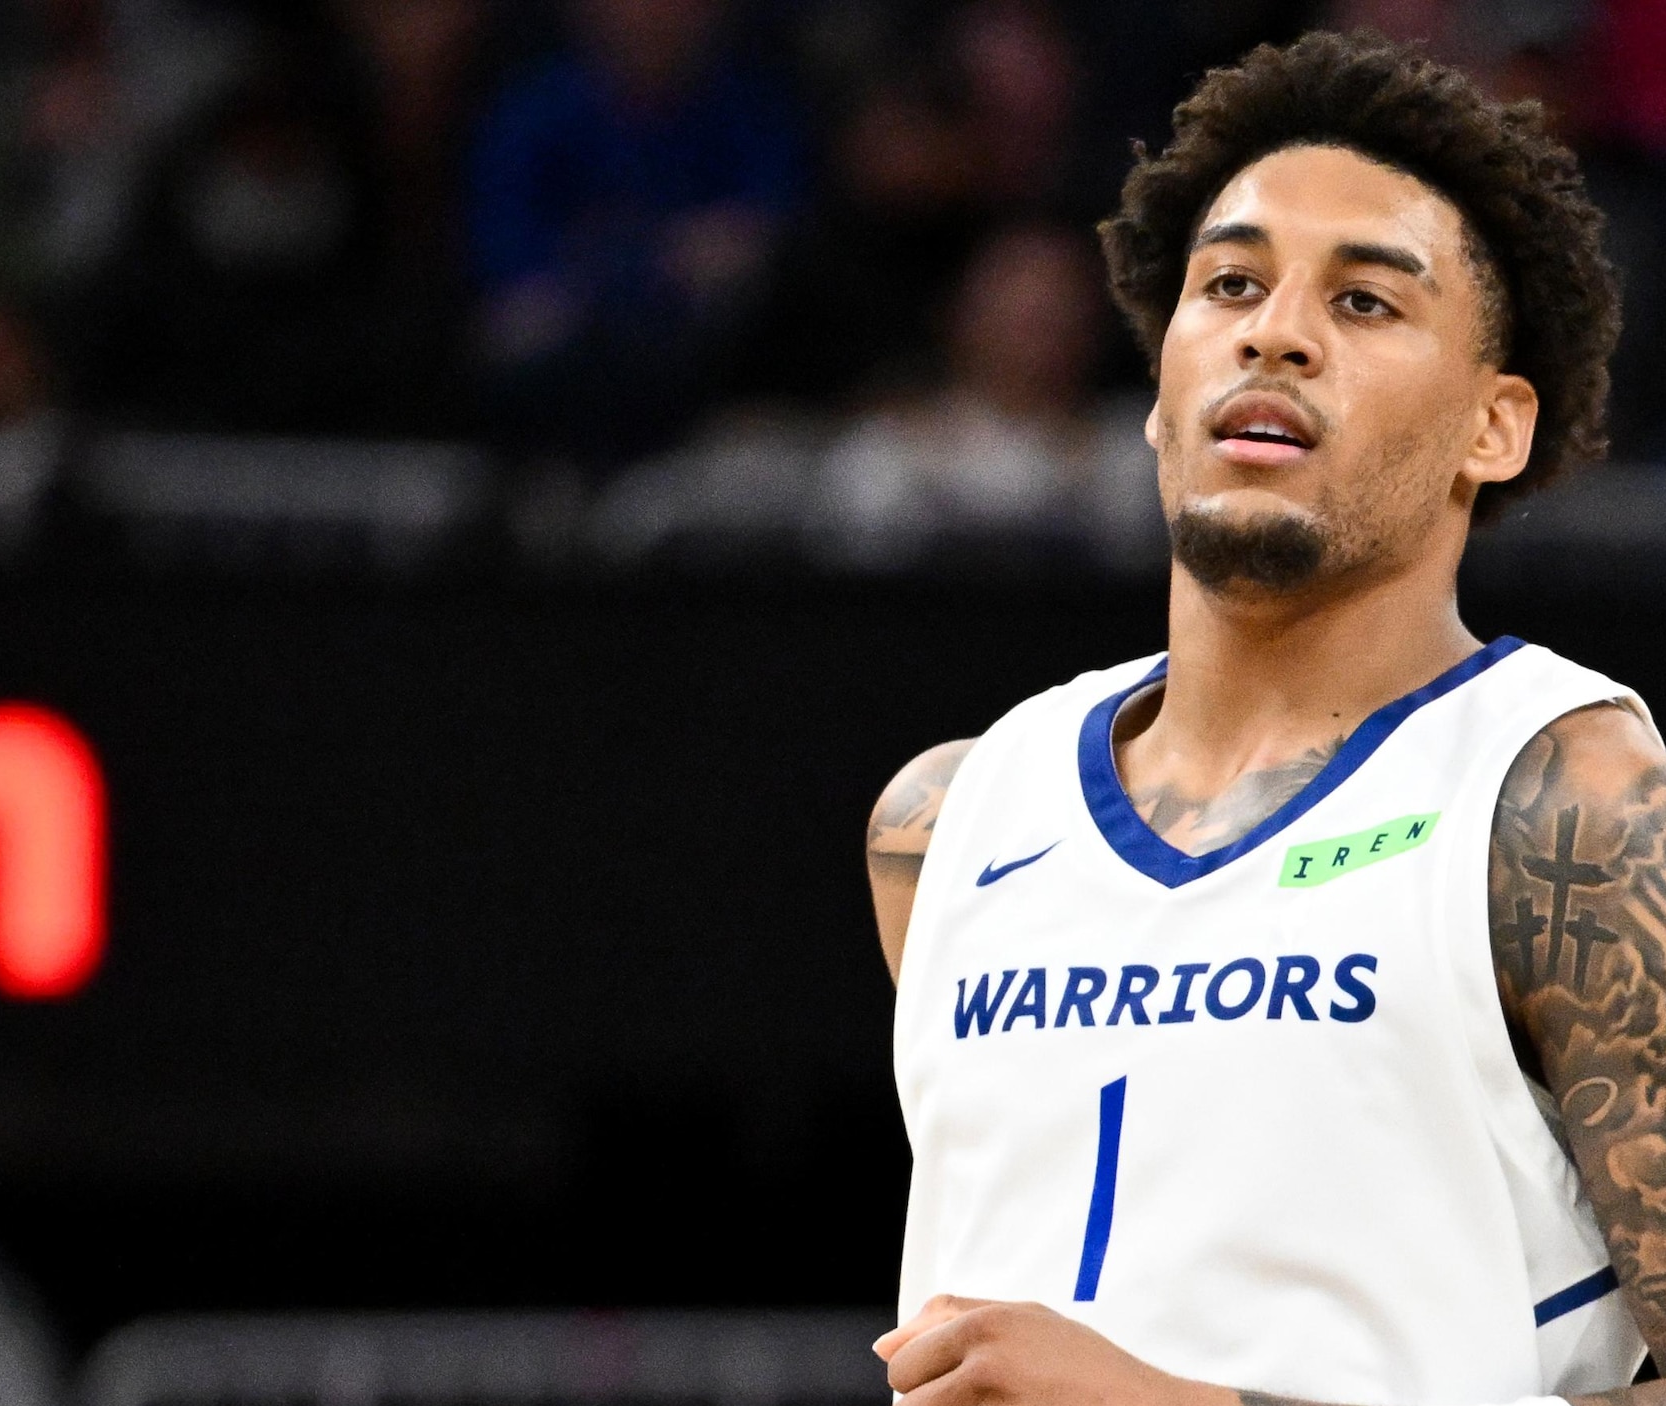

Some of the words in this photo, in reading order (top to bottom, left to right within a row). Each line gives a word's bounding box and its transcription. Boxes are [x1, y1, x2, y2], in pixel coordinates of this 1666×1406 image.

[1293, 820, 1427, 880] IREN
[953, 953, 1378, 1040] WARRIORS
[1073, 1075, 1127, 1302] 1
